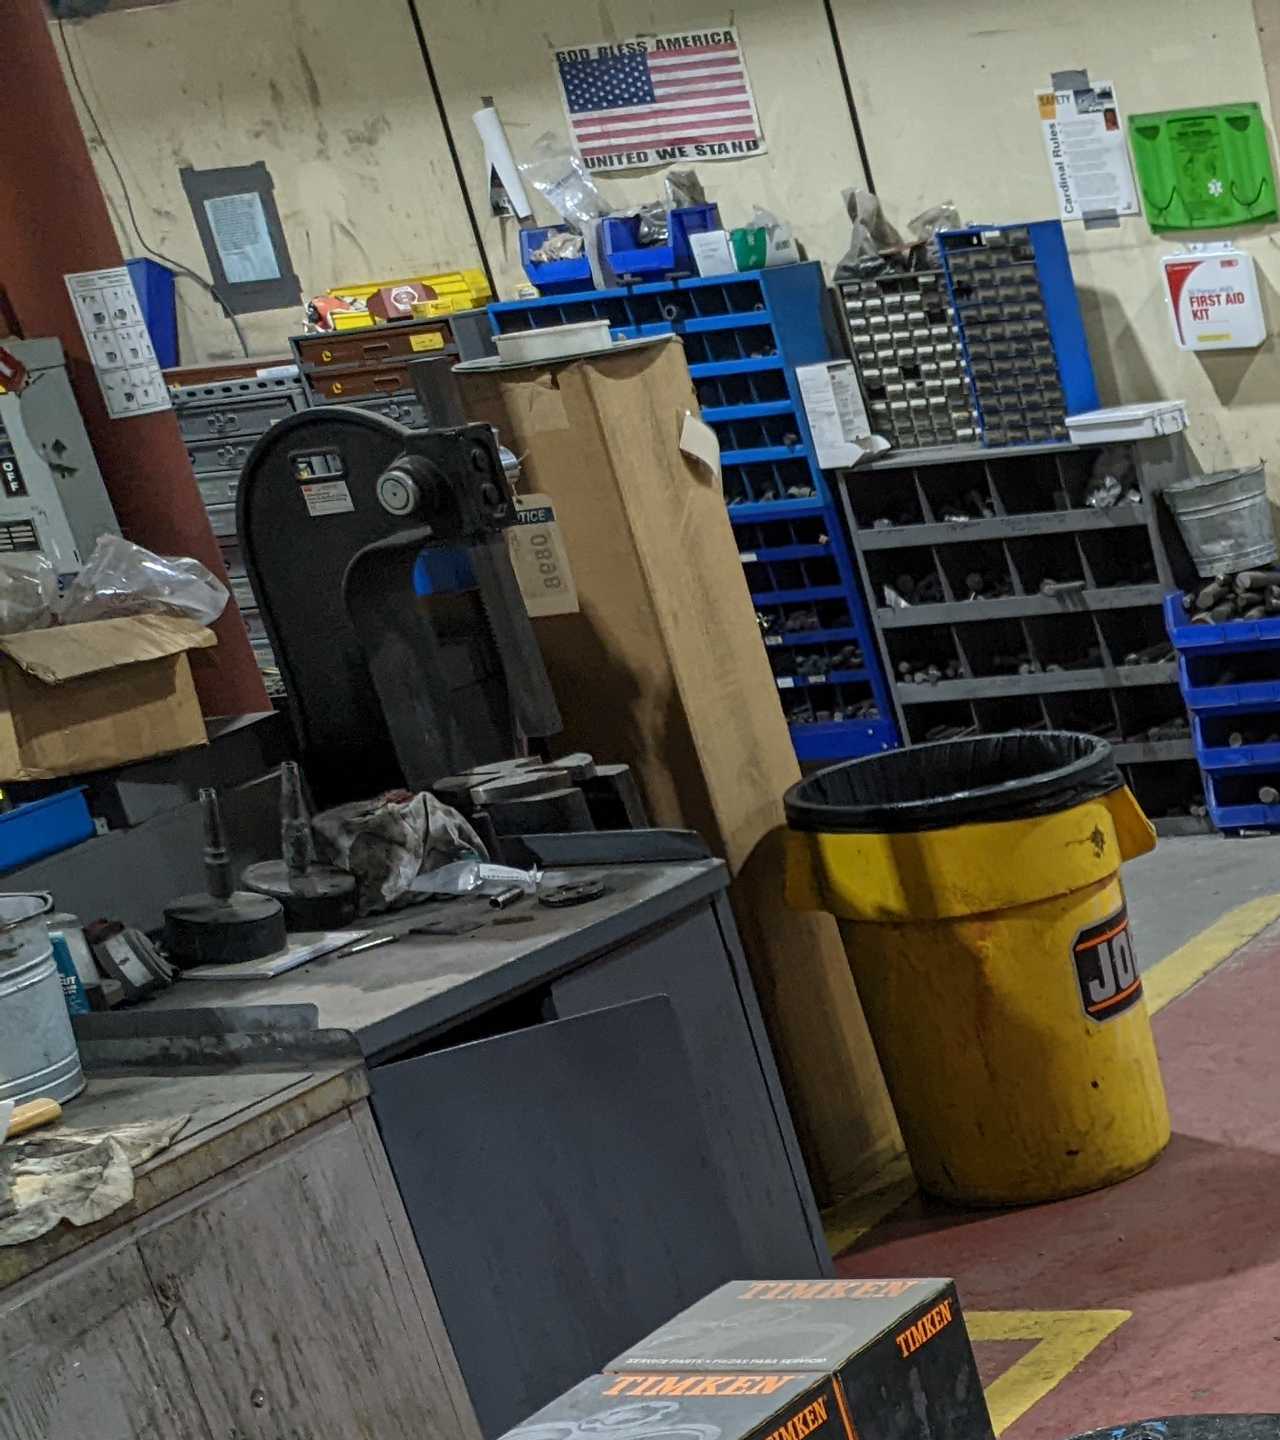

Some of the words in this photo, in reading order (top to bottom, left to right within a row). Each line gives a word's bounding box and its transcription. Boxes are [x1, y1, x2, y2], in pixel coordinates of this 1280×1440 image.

[556, 49, 589, 63] GOD
[600, 41, 647, 58] BLESS
[655, 30, 735, 51] AMERICA
[583, 151, 649, 169] UNITED
[656, 145, 688, 161] WE
[696, 139, 760, 157] STAND
[1048, 122, 1063, 159] Rules
[1056, 160, 1075, 214] Cardinal
[1189, 293, 1222, 308] FIRST
[1225, 292, 1245, 305] AID
[1191, 308, 1210, 321] KIT
[1, 461, 19, 493] OFF
[737, 1280, 920, 1301] TIMKEN
[896, 1298, 954, 1360] TIMKEN
[602, 1376, 798, 1397] TIMKEN
